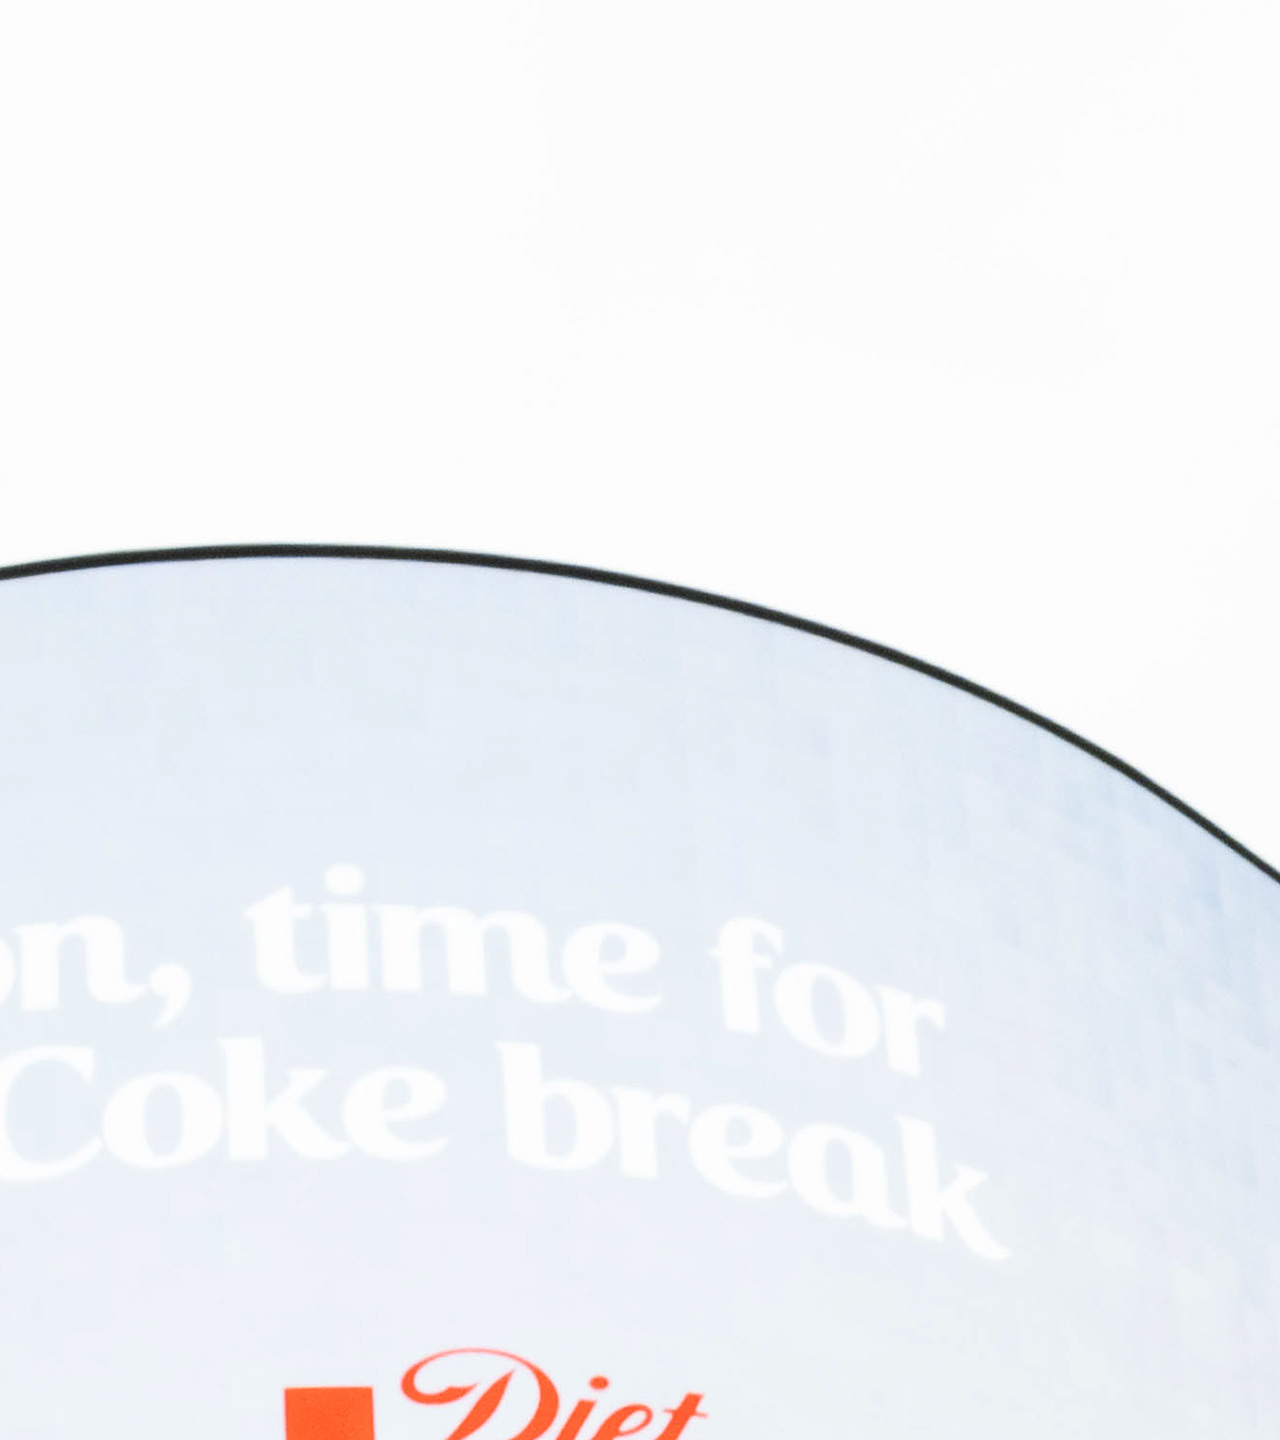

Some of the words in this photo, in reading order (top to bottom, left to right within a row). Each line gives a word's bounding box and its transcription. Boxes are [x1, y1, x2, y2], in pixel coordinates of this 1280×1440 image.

[245, 863, 660, 1014] time
[709, 918, 947, 1078] for
[493, 1042, 1010, 1261] break
